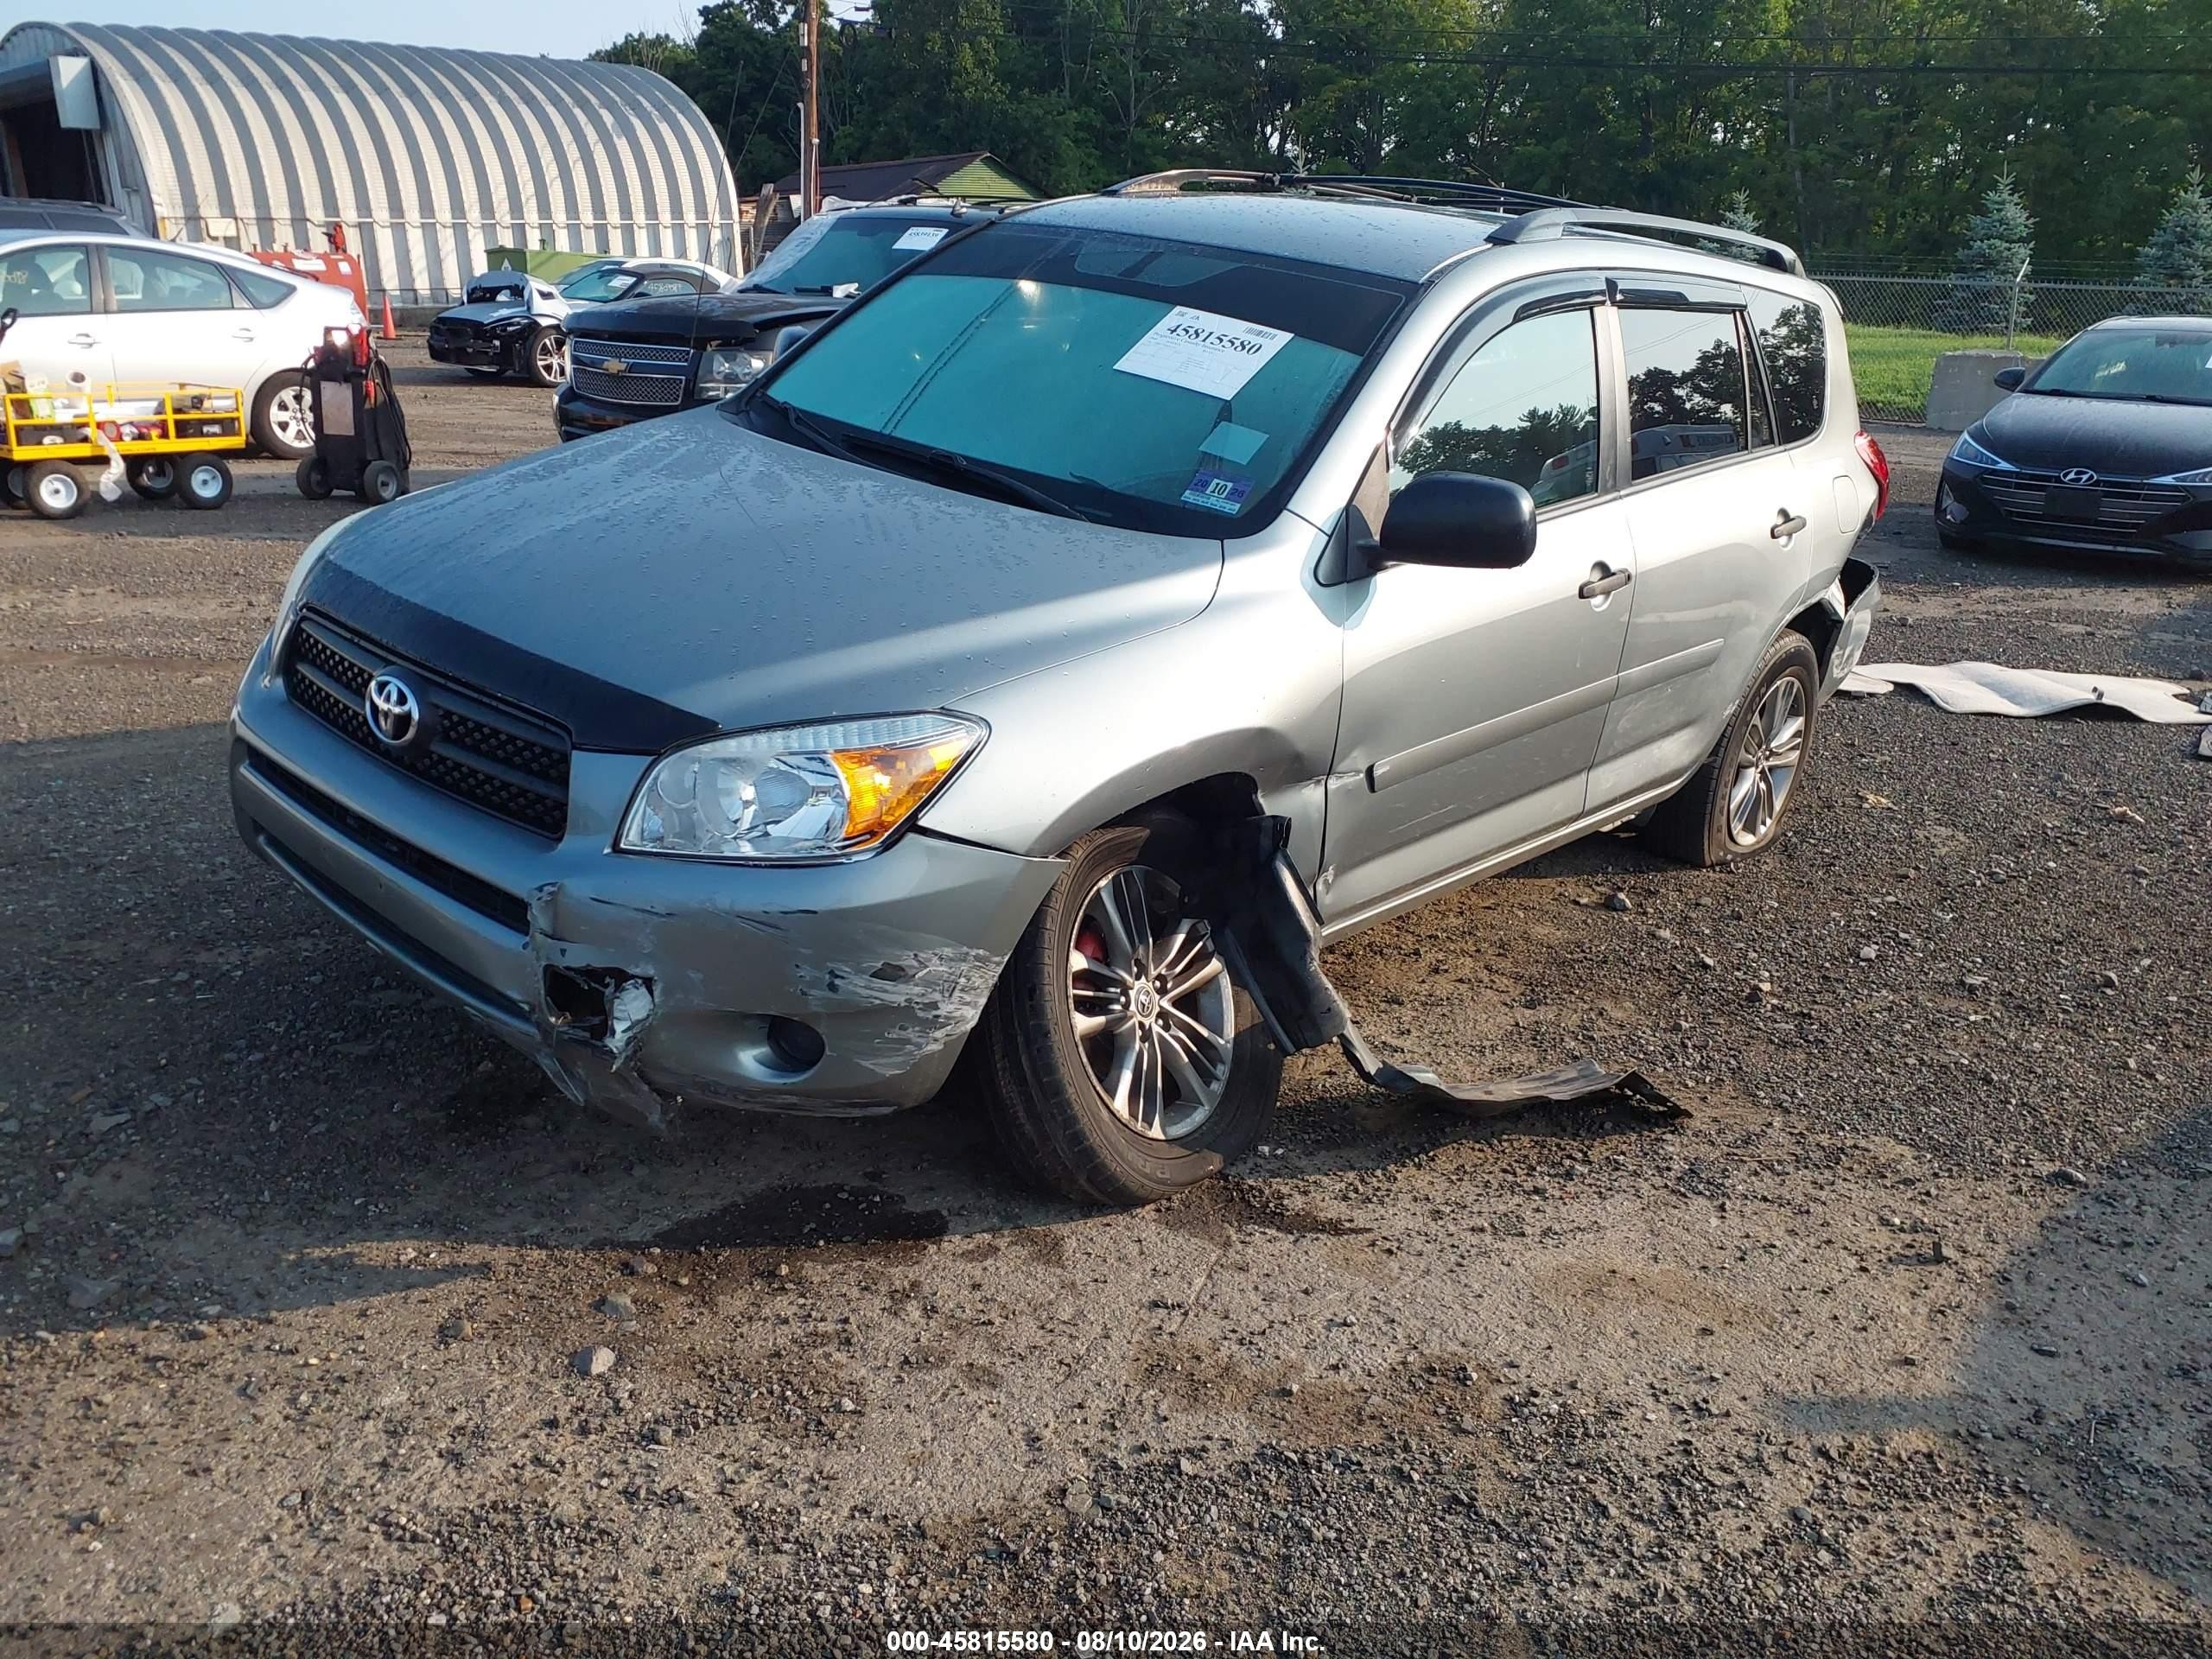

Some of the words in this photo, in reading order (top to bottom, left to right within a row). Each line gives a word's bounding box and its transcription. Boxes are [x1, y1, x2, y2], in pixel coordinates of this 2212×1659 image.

[1166, 323, 1262, 355] 45815580
[1194, 479, 1209, 488] 20
[1210, 482, 1228, 496] 10
